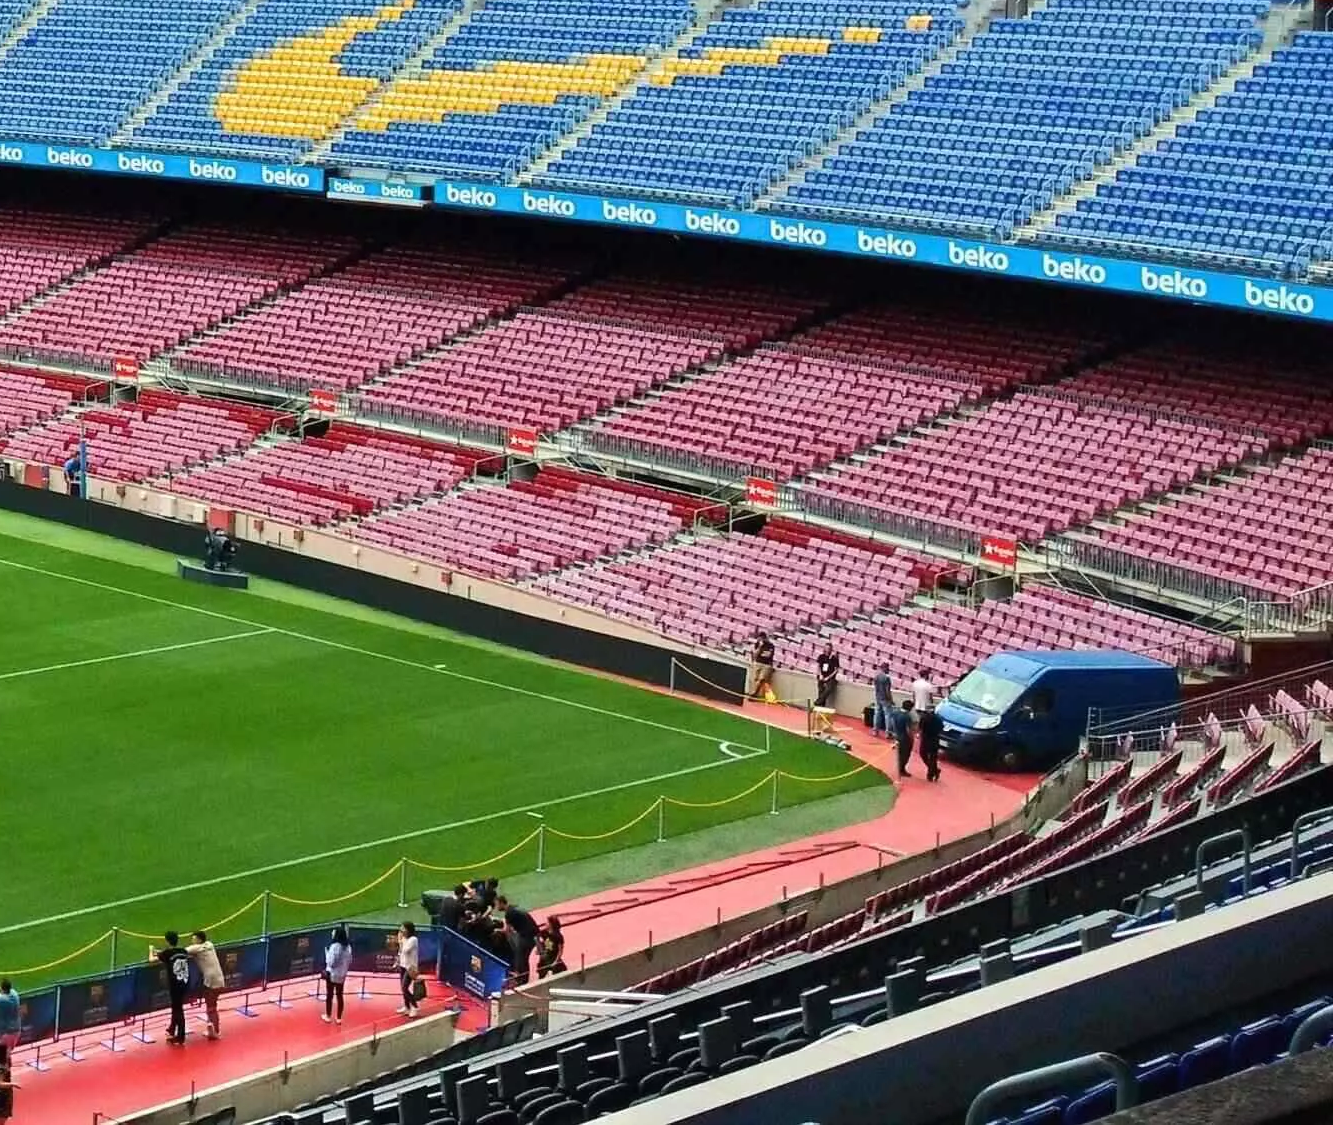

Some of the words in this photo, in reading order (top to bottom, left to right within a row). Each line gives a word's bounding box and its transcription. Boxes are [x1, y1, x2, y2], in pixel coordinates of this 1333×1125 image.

[48, 147, 92, 166] beko
[119, 154, 164, 173] beko
[190, 160, 236, 179] beko
[262, 166, 309, 187] beko
[333, 180, 366, 195] beko
[382, 186, 413, 198] beko
[448, 184, 495, 206] beko
[524, 192, 574, 215] beko
[604, 201, 656, 224] beko
[686, 210, 739, 234] beko
[771, 220, 825, 245] beko
[859, 231, 916, 257] beko
[949, 242, 1008, 270] beko
[1044, 254, 1105, 283] beko
[1142, 267, 1206, 296] beko
[1245, 281, 1314, 313] beko
